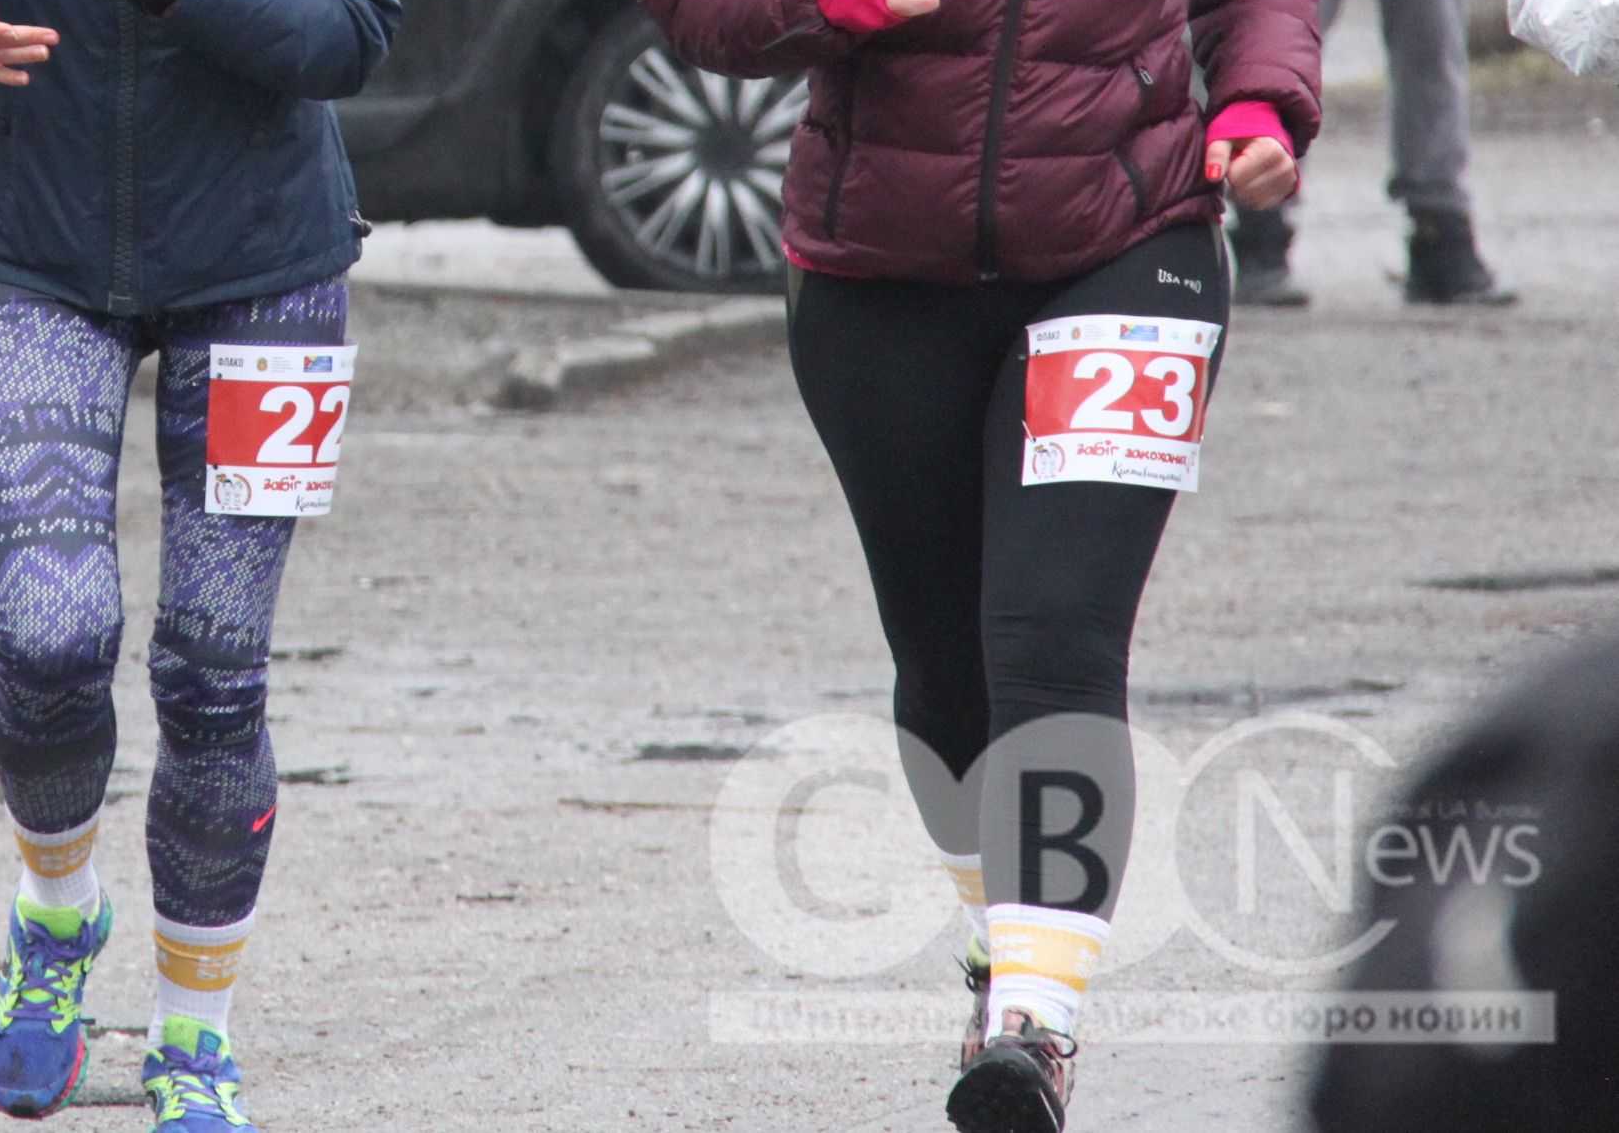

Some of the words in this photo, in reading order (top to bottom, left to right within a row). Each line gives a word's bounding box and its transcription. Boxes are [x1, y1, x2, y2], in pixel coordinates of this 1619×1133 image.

[1158, 268, 1181, 284] USA
[256, 385, 350, 464] 22
[1069, 352, 1197, 437] 23
